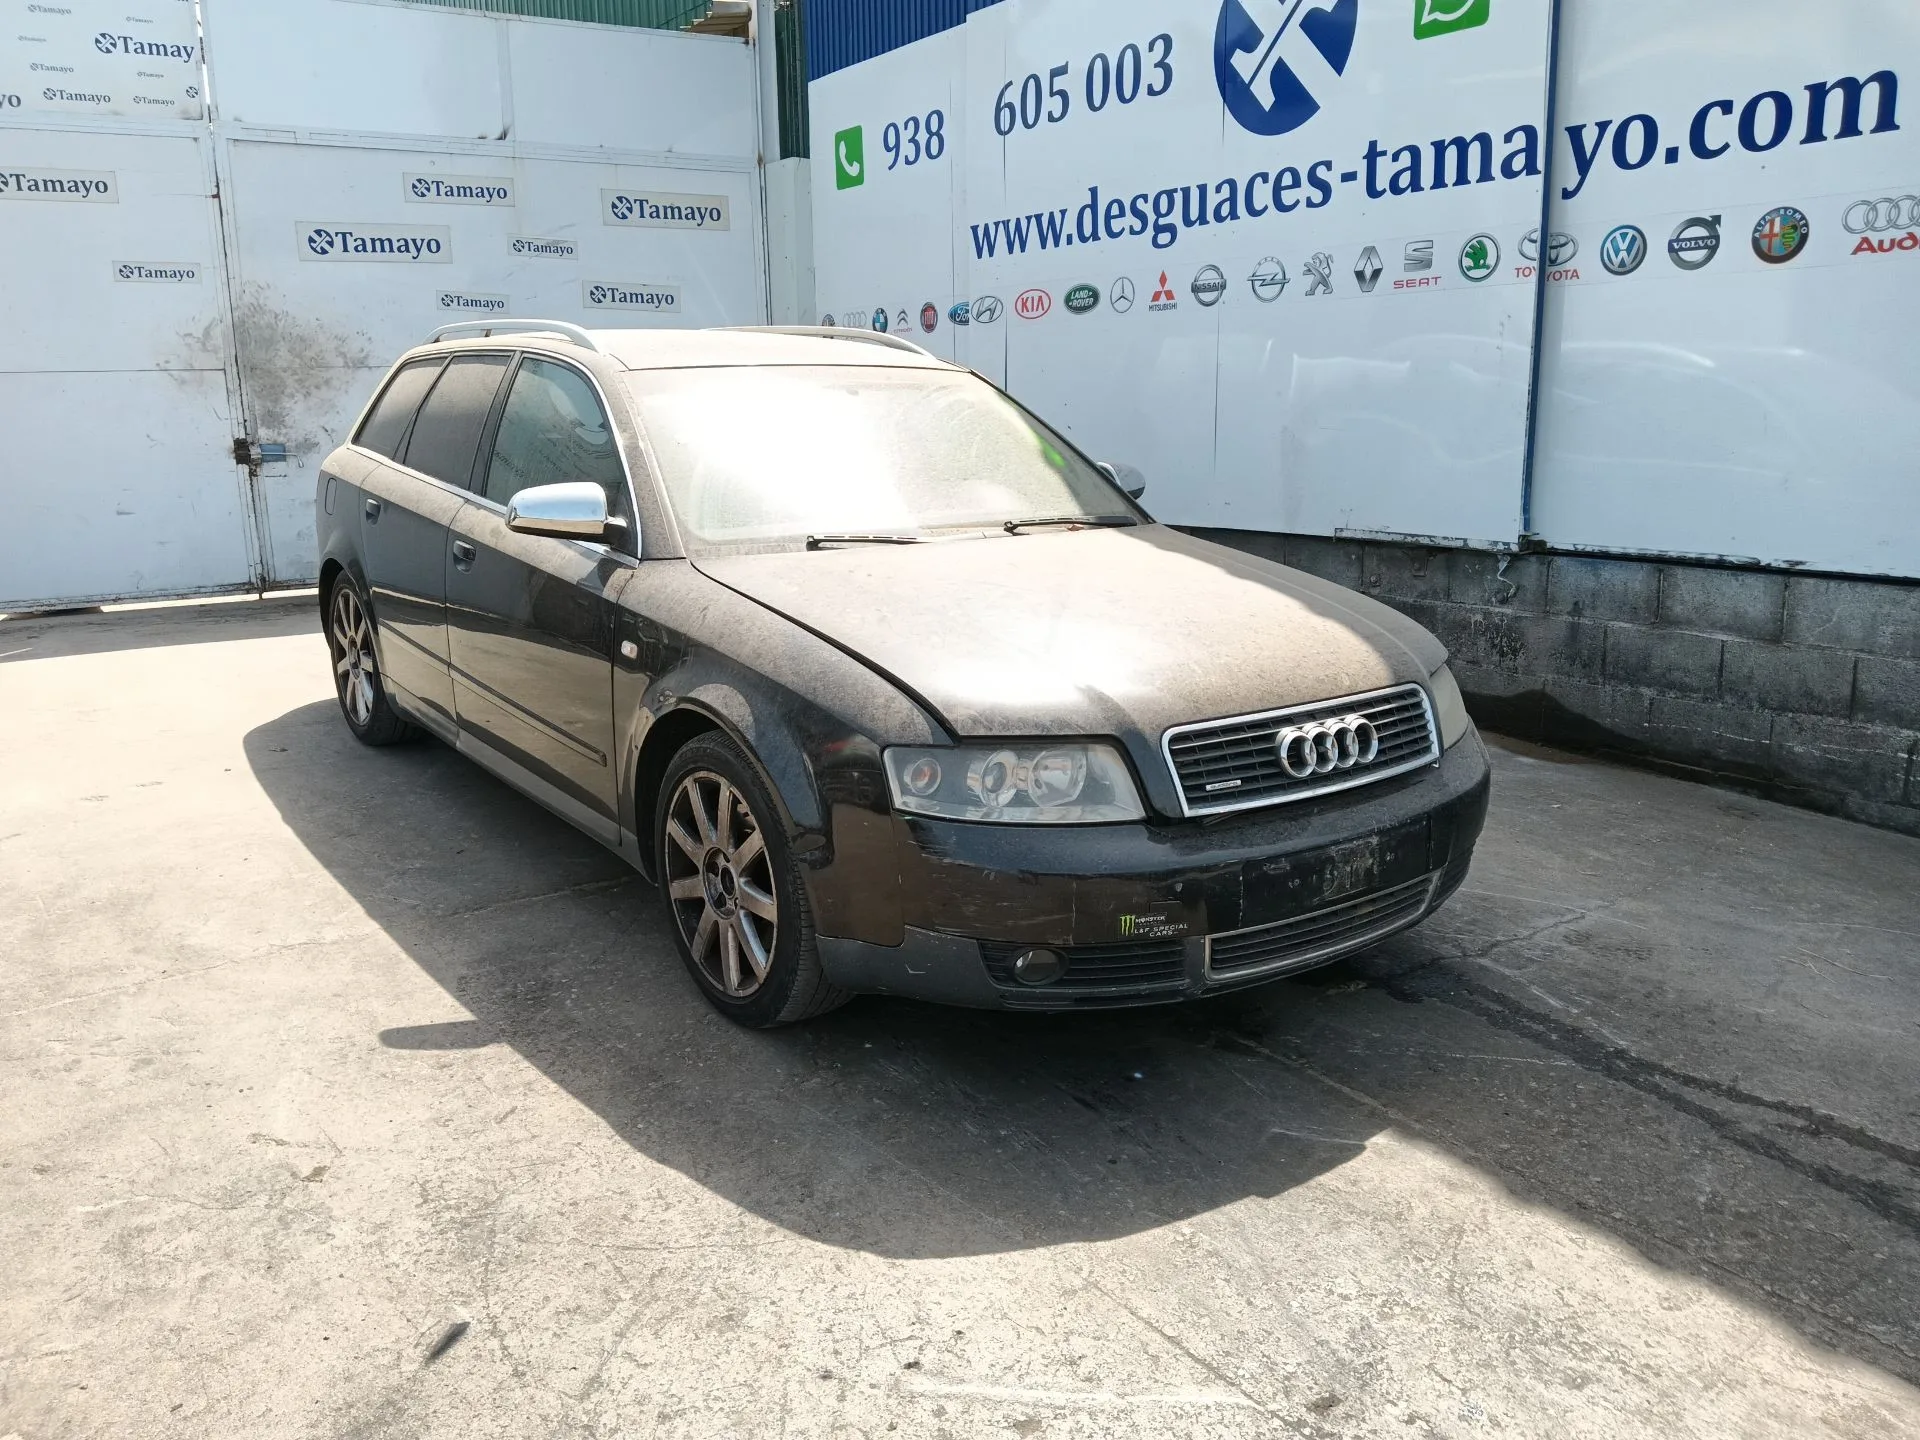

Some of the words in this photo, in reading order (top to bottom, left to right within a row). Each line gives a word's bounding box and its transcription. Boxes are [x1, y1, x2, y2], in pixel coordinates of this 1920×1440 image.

[38, 63, 74, 74] Tamayo
[56, 89, 111, 105] Tamayo
[141, 96, 175, 106] Tamayo
[883, 109, 945, 171] 938
[994, 61, 1070, 136] 605
[1085, 33, 1173, 112] 003
[970, 69, 1900, 259] www.desguaces-tamayo.com
[9, 173, 109, 198] Tamayo
[431, 180, 508, 203] Tamayo
[634, 198, 722, 227] Tamayo
[334, 231, 442, 260] Tamayo
[525, 241, 574, 256] Tamayo
[1672, 238, 1716, 250] VOLVO
[1850, 232, 1920, 255] Aud
[134, 266, 195, 281] Tamayo
[1393, 276, 1442, 289] SEAT
[607, 287, 675, 308] Tamayo
[1071, 289, 1089, 299] LAND
[454, 295, 505, 311] Tamayo
[1021, 295, 1045, 313] KIA
[1072, 297, 1094, 308] ROVER
[1148, 302, 1178, 312] MITSUBISHI
[1153, 923, 1188, 932] SPECIAL
